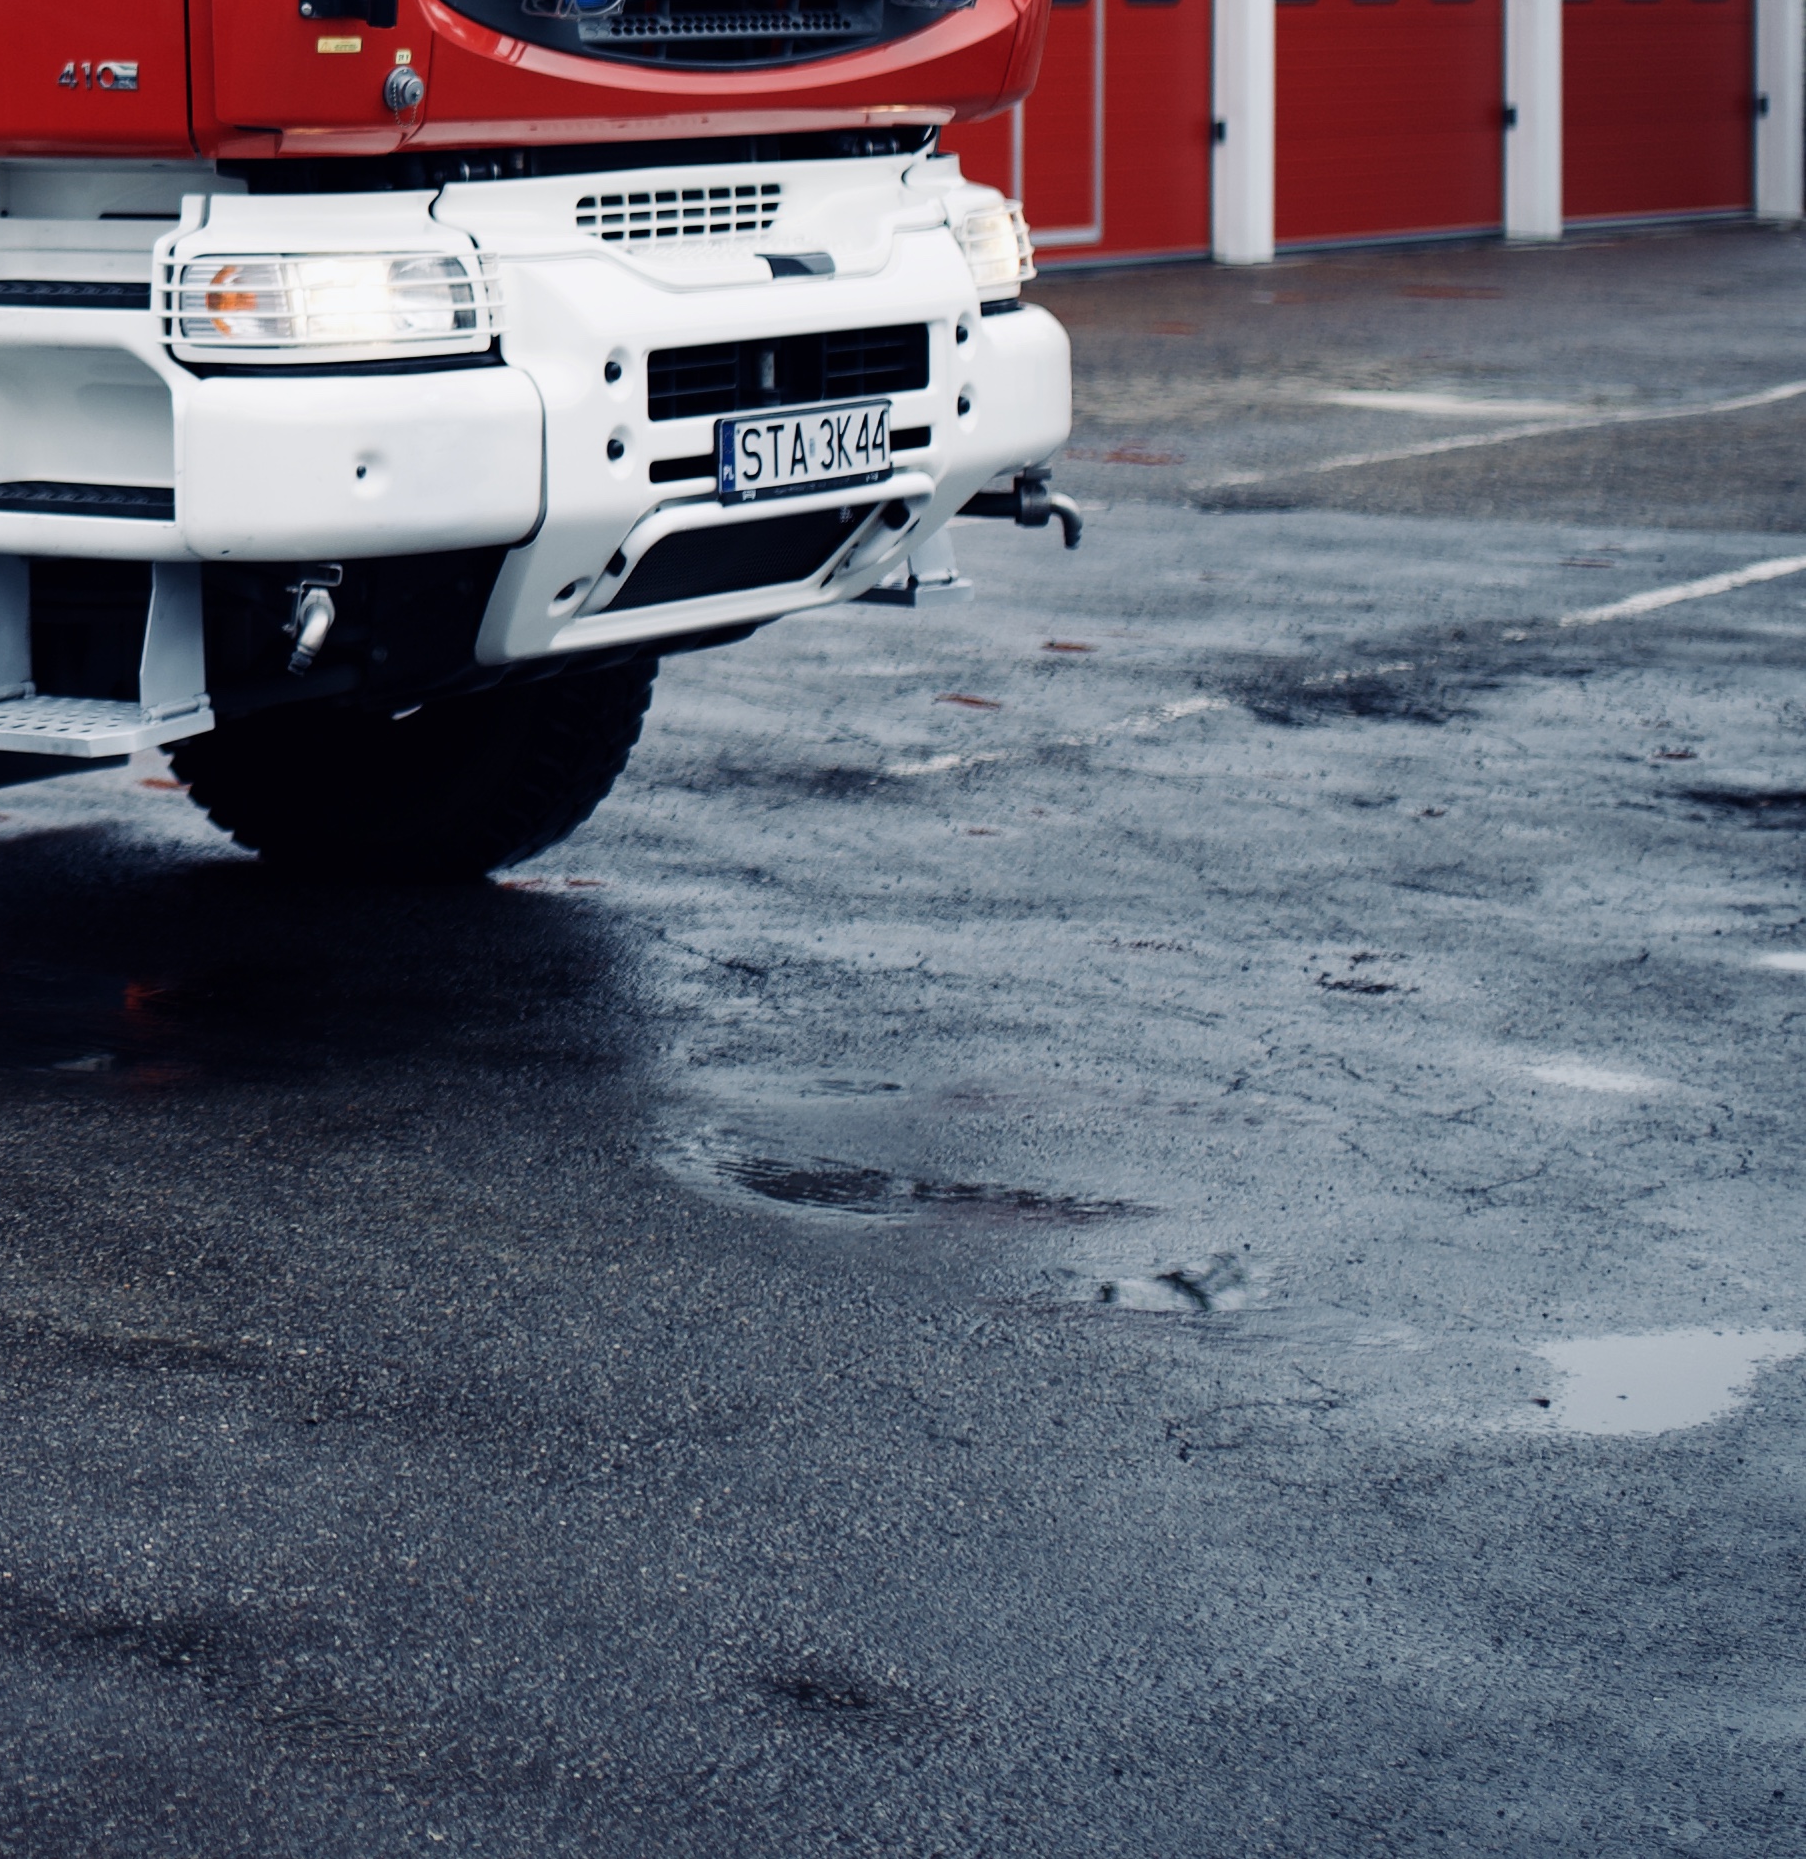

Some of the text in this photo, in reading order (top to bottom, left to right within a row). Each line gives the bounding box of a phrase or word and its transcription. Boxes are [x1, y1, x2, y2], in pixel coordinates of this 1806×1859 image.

[57, 61, 138, 91] 410
[741, 409, 887, 481] STA 3K44
[723, 463, 735, 481] PL
